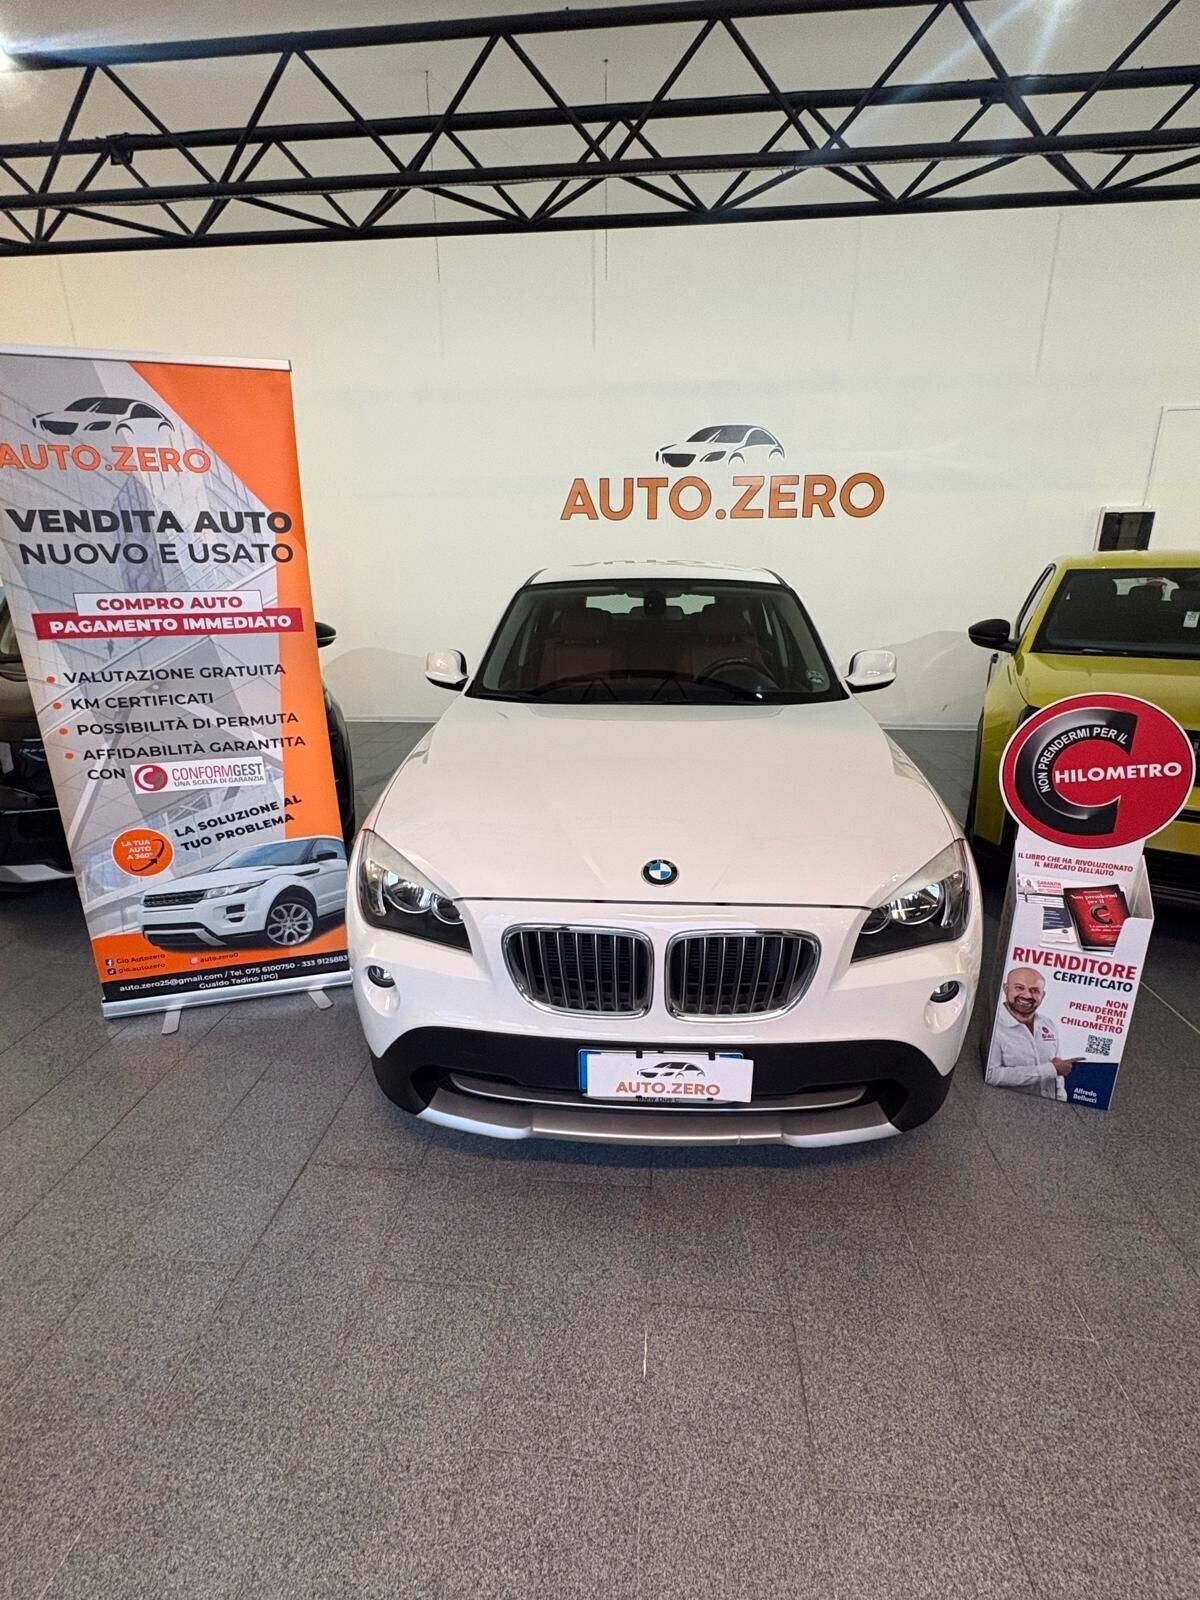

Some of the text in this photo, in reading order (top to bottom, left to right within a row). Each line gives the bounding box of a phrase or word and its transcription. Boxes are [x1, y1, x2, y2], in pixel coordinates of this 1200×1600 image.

[0, 443, 212, 474] AUTO.ZERO
[560, 472, 885, 521] AUTO.ZERO
[5, 509, 292, 533] VENDITA AUTO
[19, 543, 294, 565] NUOVO E USATO
[96, 596, 243, 612] COMPRO AUTO
[50, 614, 292, 634] PAGAMENTO IMMEDIATO
[63, 663, 286, 684] VALUTAZIONE GRATUITA
[70, 692, 214, 711] KM CERTIFICATI
[77, 712, 298, 736] POSSIBILITÀ DI PERMUTA
[83, 735, 307, 761] AFFIDABILITÀ GARANTITA
[1038, 727, 1129, 793] NON PRENDERMI PER IL
[87, 763, 263, 781] CON CONFORMGEST
[192, 778, 218, 786] SCELTA
[228, 775, 264, 783] GARANZIA
[174, 794, 302, 838] LA SOLUZIONE AL
[181, 813, 295, 851] TUO PROBLEMA
[132, 839, 151, 847] TUA
[1025, 853, 1046, 861] LIBRO
[1075, 859, 1134, 873] RIVOLUZIONATO
[1043, 862, 1077, 872] MERCATO
[1077, 866, 1115, 877] DELL'AUTO
[230, 968, 244, 977] Tel.
[245, 966, 261, 975] 075
[1012, 946, 1137, 980] RIVENDITORE
[230, 975, 260, 985] Tadino
[1053, 970, 1133, 993] CERTIFICATO
[1069, 1001, 1127, 1019] PRENDERMI
[1105, 999, 1129, 1011] NON
[1060, 1016, 1123, 1035] CHILOMETRO
[1095, 1014, 1125, 1027] PER IL
[615, 1081, 721, 1096] AUTO.ZERO
